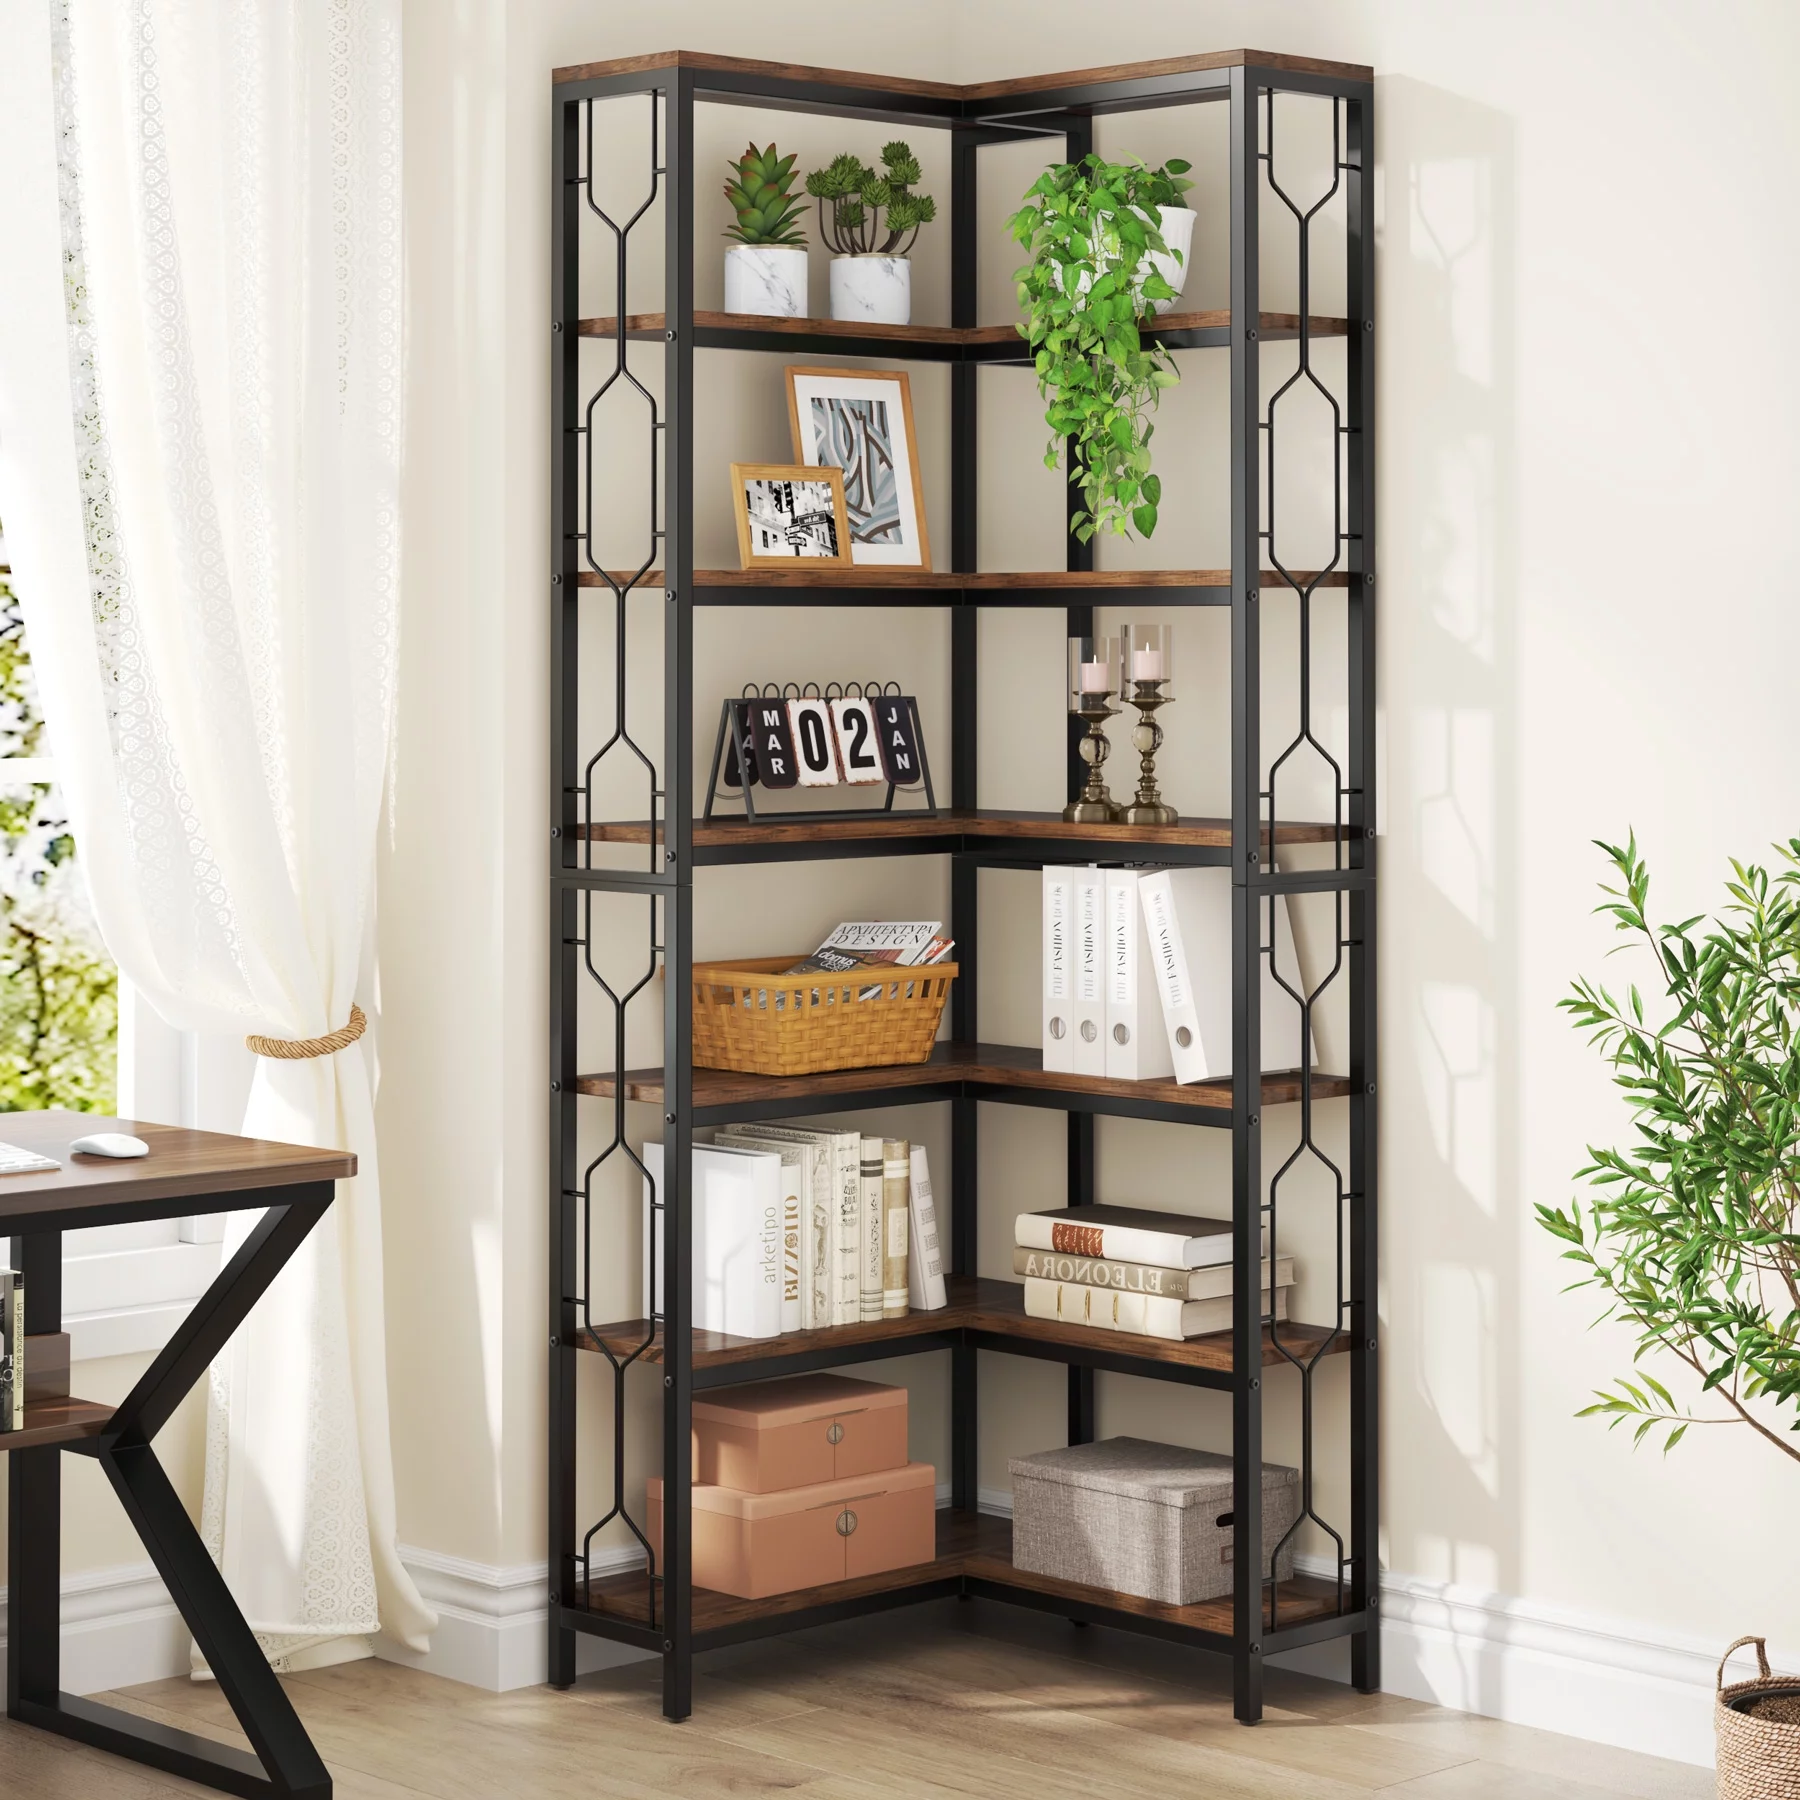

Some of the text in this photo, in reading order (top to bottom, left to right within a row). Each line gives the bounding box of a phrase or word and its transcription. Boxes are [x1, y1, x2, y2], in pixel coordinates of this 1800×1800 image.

[762, 710, 786, 775] MAR
[888, 707, 911, 770] JAN
[818, 949, 857, 966] domus
[834, 934, 925, 945] DESIGN
[1053, 885, 1062, 997] THE FASHION BOOK
[1084, 887, 1094, 999] THE FASHION BOOK
[1117, 889, 1126, 1001] THE FASHION BOOK
[1153, 892, 1183, 1006] THE FASHION BOOK
[760, 1206, 778, 1284] arketipo
